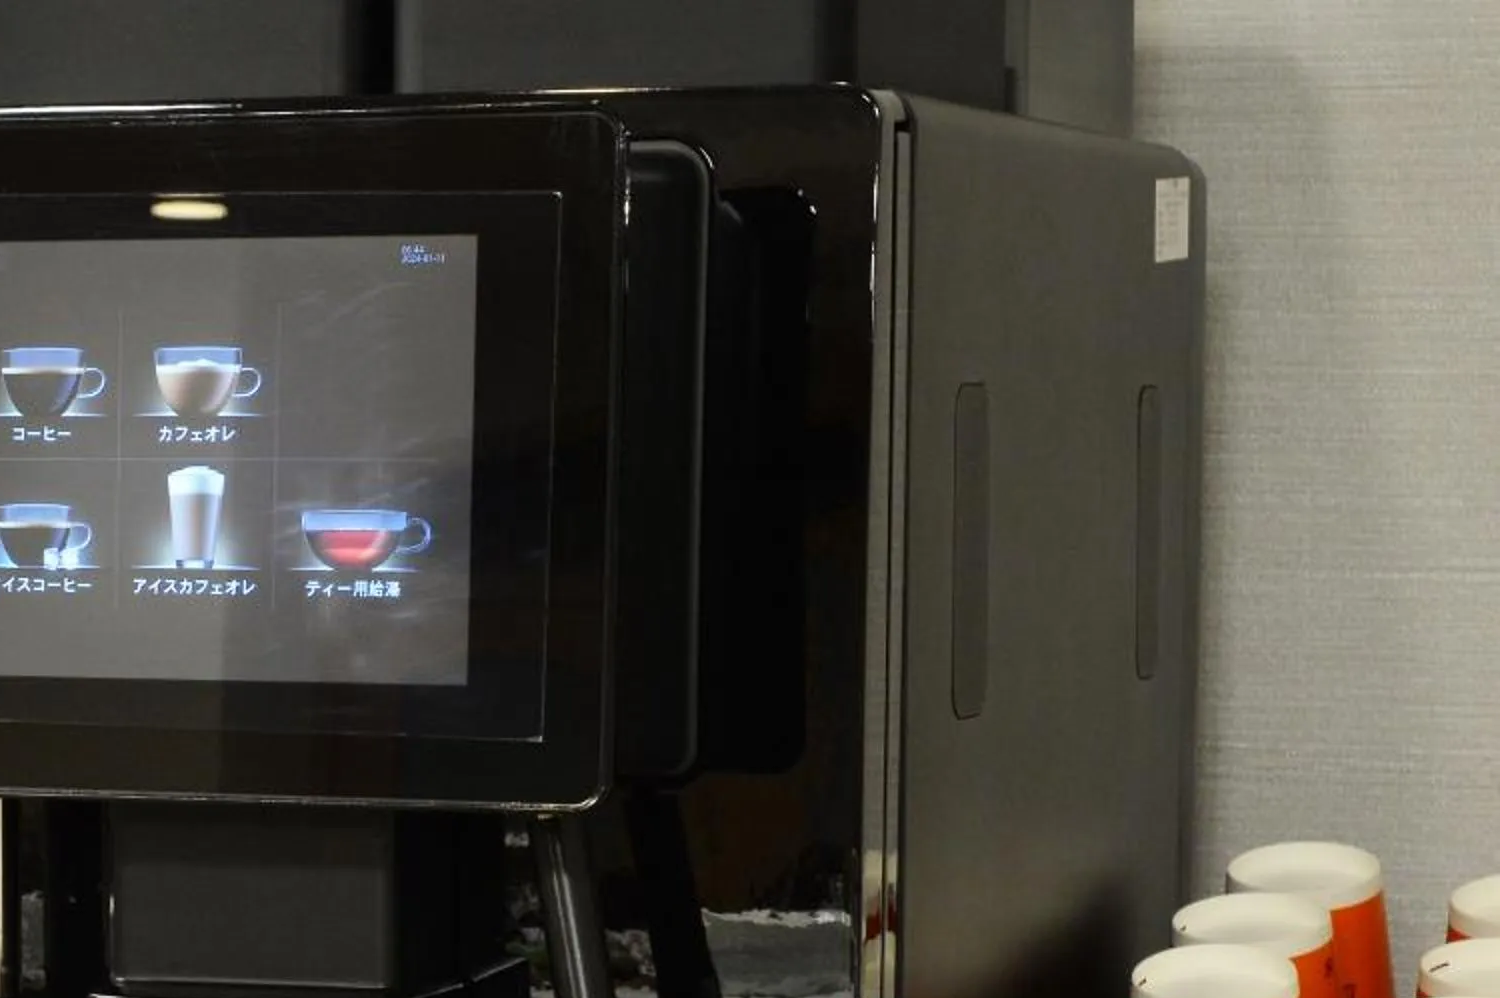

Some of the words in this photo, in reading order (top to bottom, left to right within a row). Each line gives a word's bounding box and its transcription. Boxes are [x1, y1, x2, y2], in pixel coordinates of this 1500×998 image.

[12, 426, 72, 441] コーヒー
[158, 425, 236, 441] カフェオレ
[132, 578, 256, 596] アイスカフェオレ
[304, 580, 401, 598] ティー用給湯
